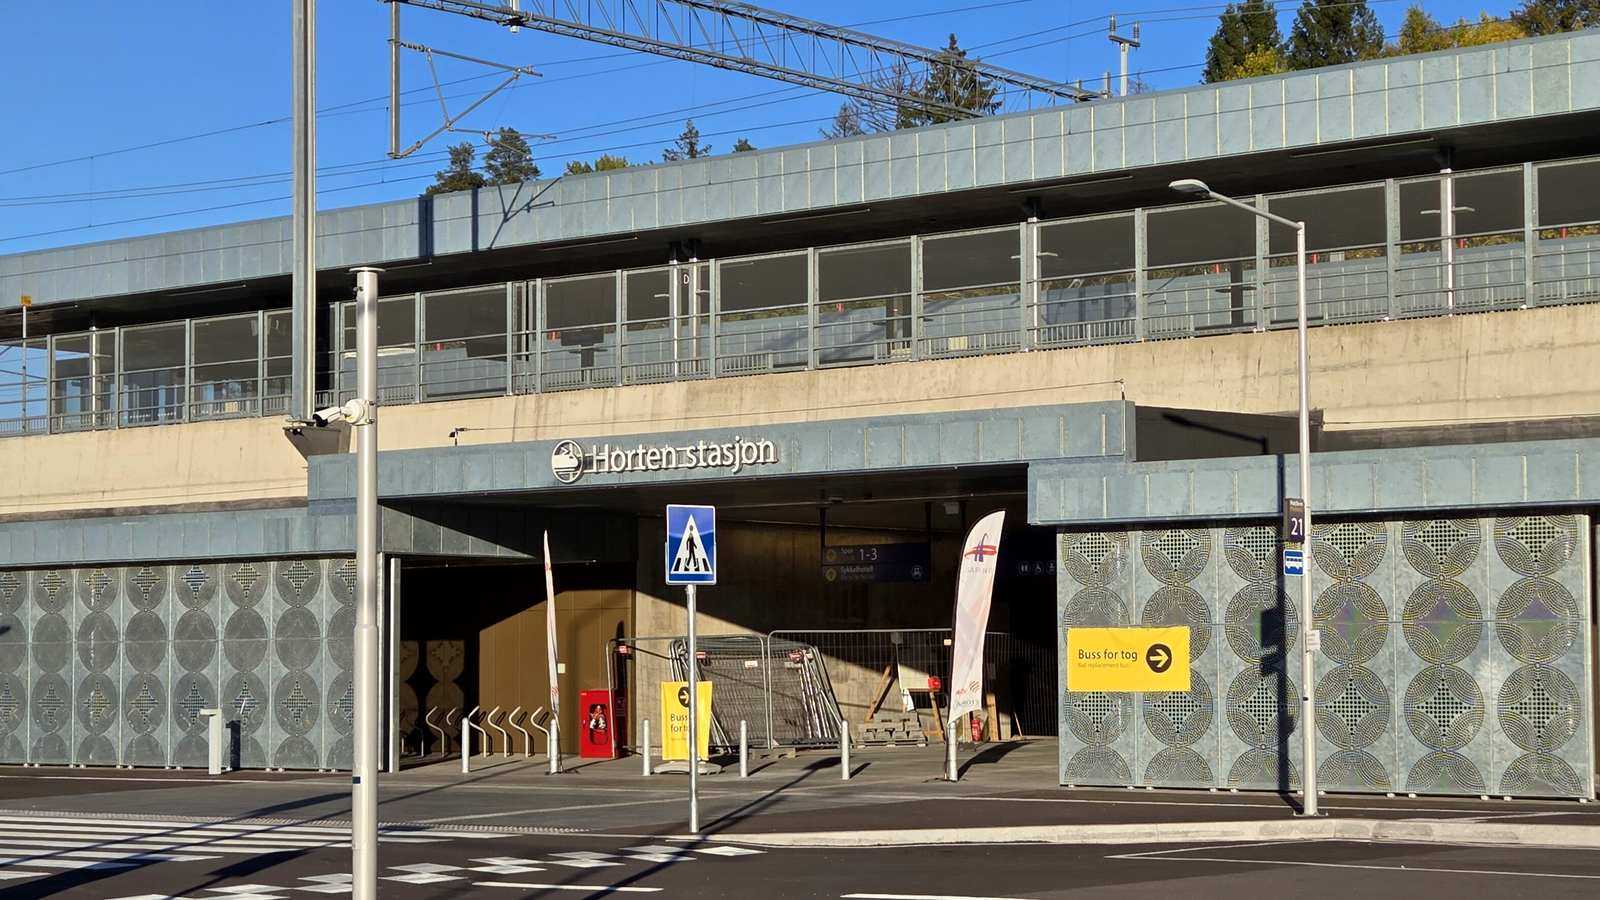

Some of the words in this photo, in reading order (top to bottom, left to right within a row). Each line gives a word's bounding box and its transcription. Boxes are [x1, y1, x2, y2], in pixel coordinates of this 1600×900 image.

[592, 443, 677, 474] Horten
[685, 436, 776, 473] stasjon
[1291, 517, 1303, 536] 21
[860, 548, 877, 561] 1-3
[1078, 648, 1101, 659] Buss
[1104, 648, 1118, 659] for
[1121, 650, 1138, 662] tog
[671, 724, 682, 732] for
